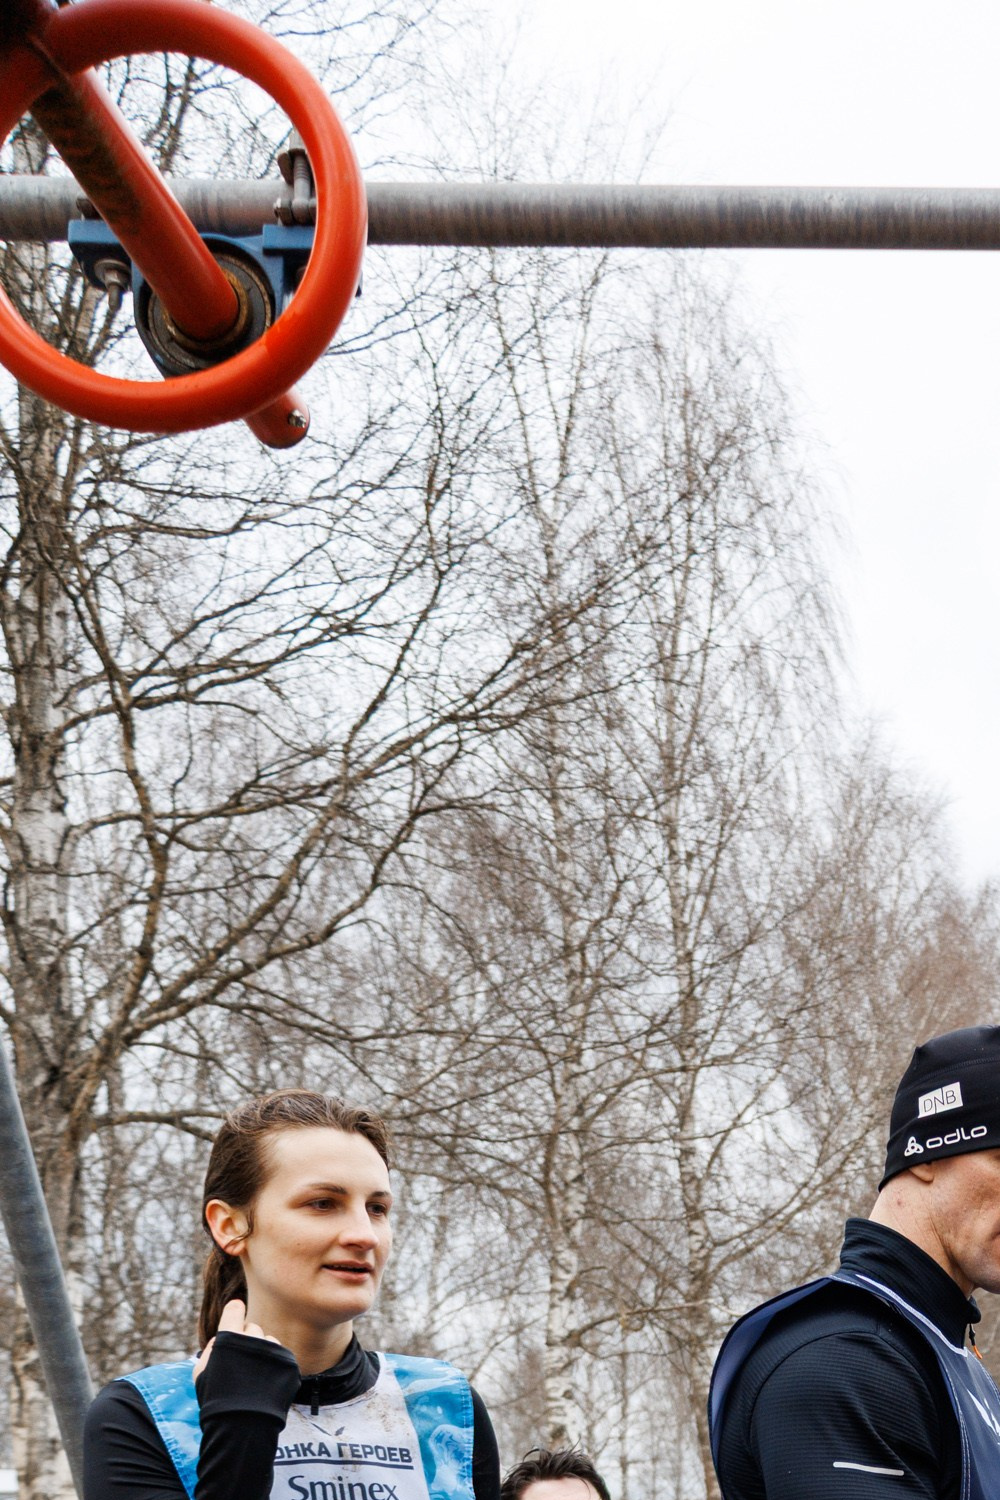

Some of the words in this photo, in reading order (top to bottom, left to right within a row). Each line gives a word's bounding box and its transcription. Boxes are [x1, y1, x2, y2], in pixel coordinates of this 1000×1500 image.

[923, 1087, 957, 1114] DNB
[926, 1125, 988, 1149] odlo
[275, 1441, 331, 1459] ОНКА
[336, 1442, 412, 1463] ГЕРОЕВ
